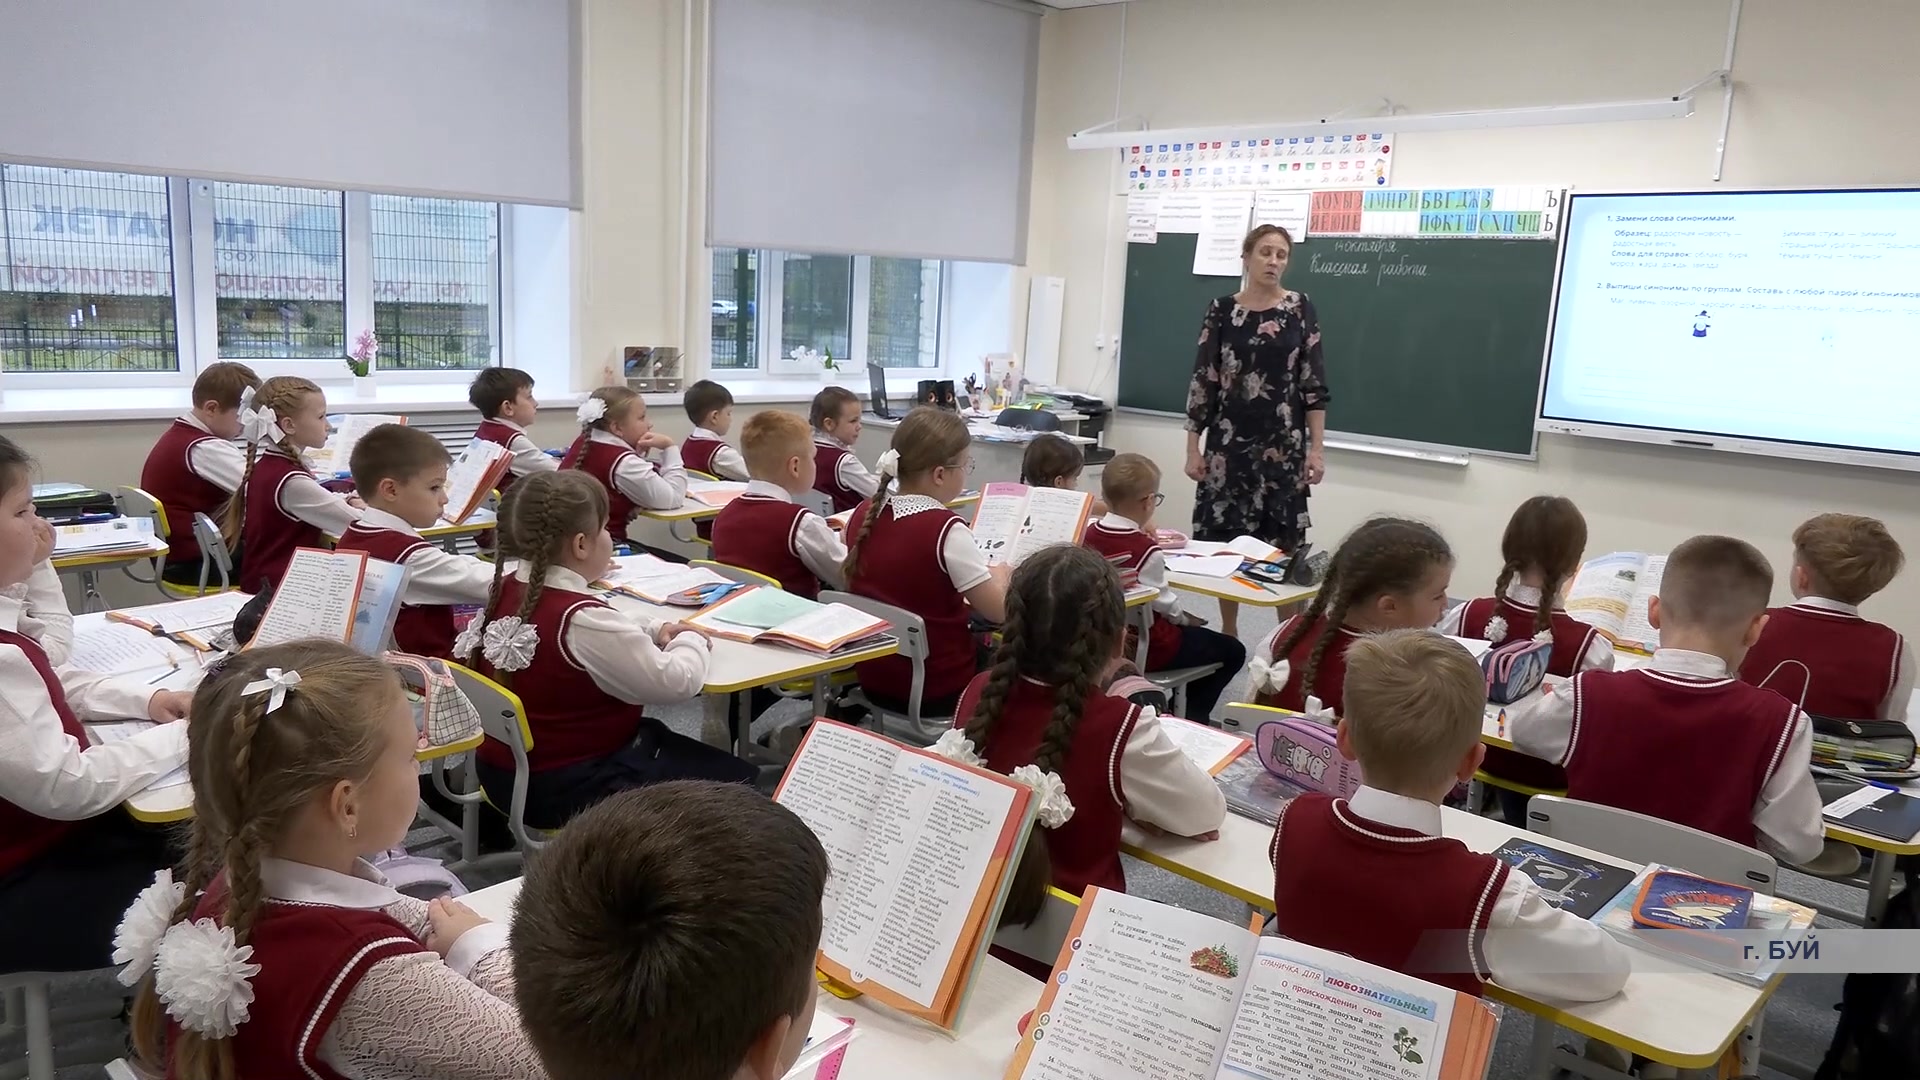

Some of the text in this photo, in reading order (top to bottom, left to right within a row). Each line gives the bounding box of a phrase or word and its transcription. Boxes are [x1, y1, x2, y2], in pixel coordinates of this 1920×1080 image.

[1310, 253, 1368, 275] Классная
[1189, 981, 1216, 995] Назовите
[1195, 976, 1212, 986] Какие
[1216, 984, 1232, 995] слова
[1260, 958, 1428, 1015] СТРАНИЧКА ДЛЯ ЛЮБОЗНАТЕЛЬНЫХ
[1281, 980, 1381, 1017] О происхождении слов
[1191, 1017, 1220, 1032] толковый
[1274, 1000, 1328, 1021] происхождение.
[1334, 1017, 1356, 1030] Слово
[1261, 1011, 1290, 1025] Растение
[1295, 1024, 1323, 1036] названо
[1342, 1039, 1378, 1056] широким,
[1285, 1012, 1304, 1022] слова
[1309, 1019, 1324, 1029] лоп,
[1330, 1026, 1343, 1034] что
[1348, 1033, 1381, 1047] означало
[1368, 1021, 1385, 1030] име-
[1132, 1031, 1150, 1041] шоссе
[1197, 1040, 1215, 1050] слова
[1274, 1025, 1300, 1039] ладонь,
[1305, 1036, 1337, 1051] листьям.
[1343, 1047, 1365, 1060] Слово
[1255, 1044, 1275, 1056] Слово
[1307, 1044, 1323, 1055] (как
[1133, 1048, 1158, 1062] толковом
[1161, 1059, 1185, 1072] словаре
[1267, 1041, 1286, 1051] слова
[1314, 1057, 1326, 1065] что
[1330, 1063, 1363, 1078] означало
[1268, 1059, 1300, 1074] значении
[1255, 1064, 1285, 1078] означает
